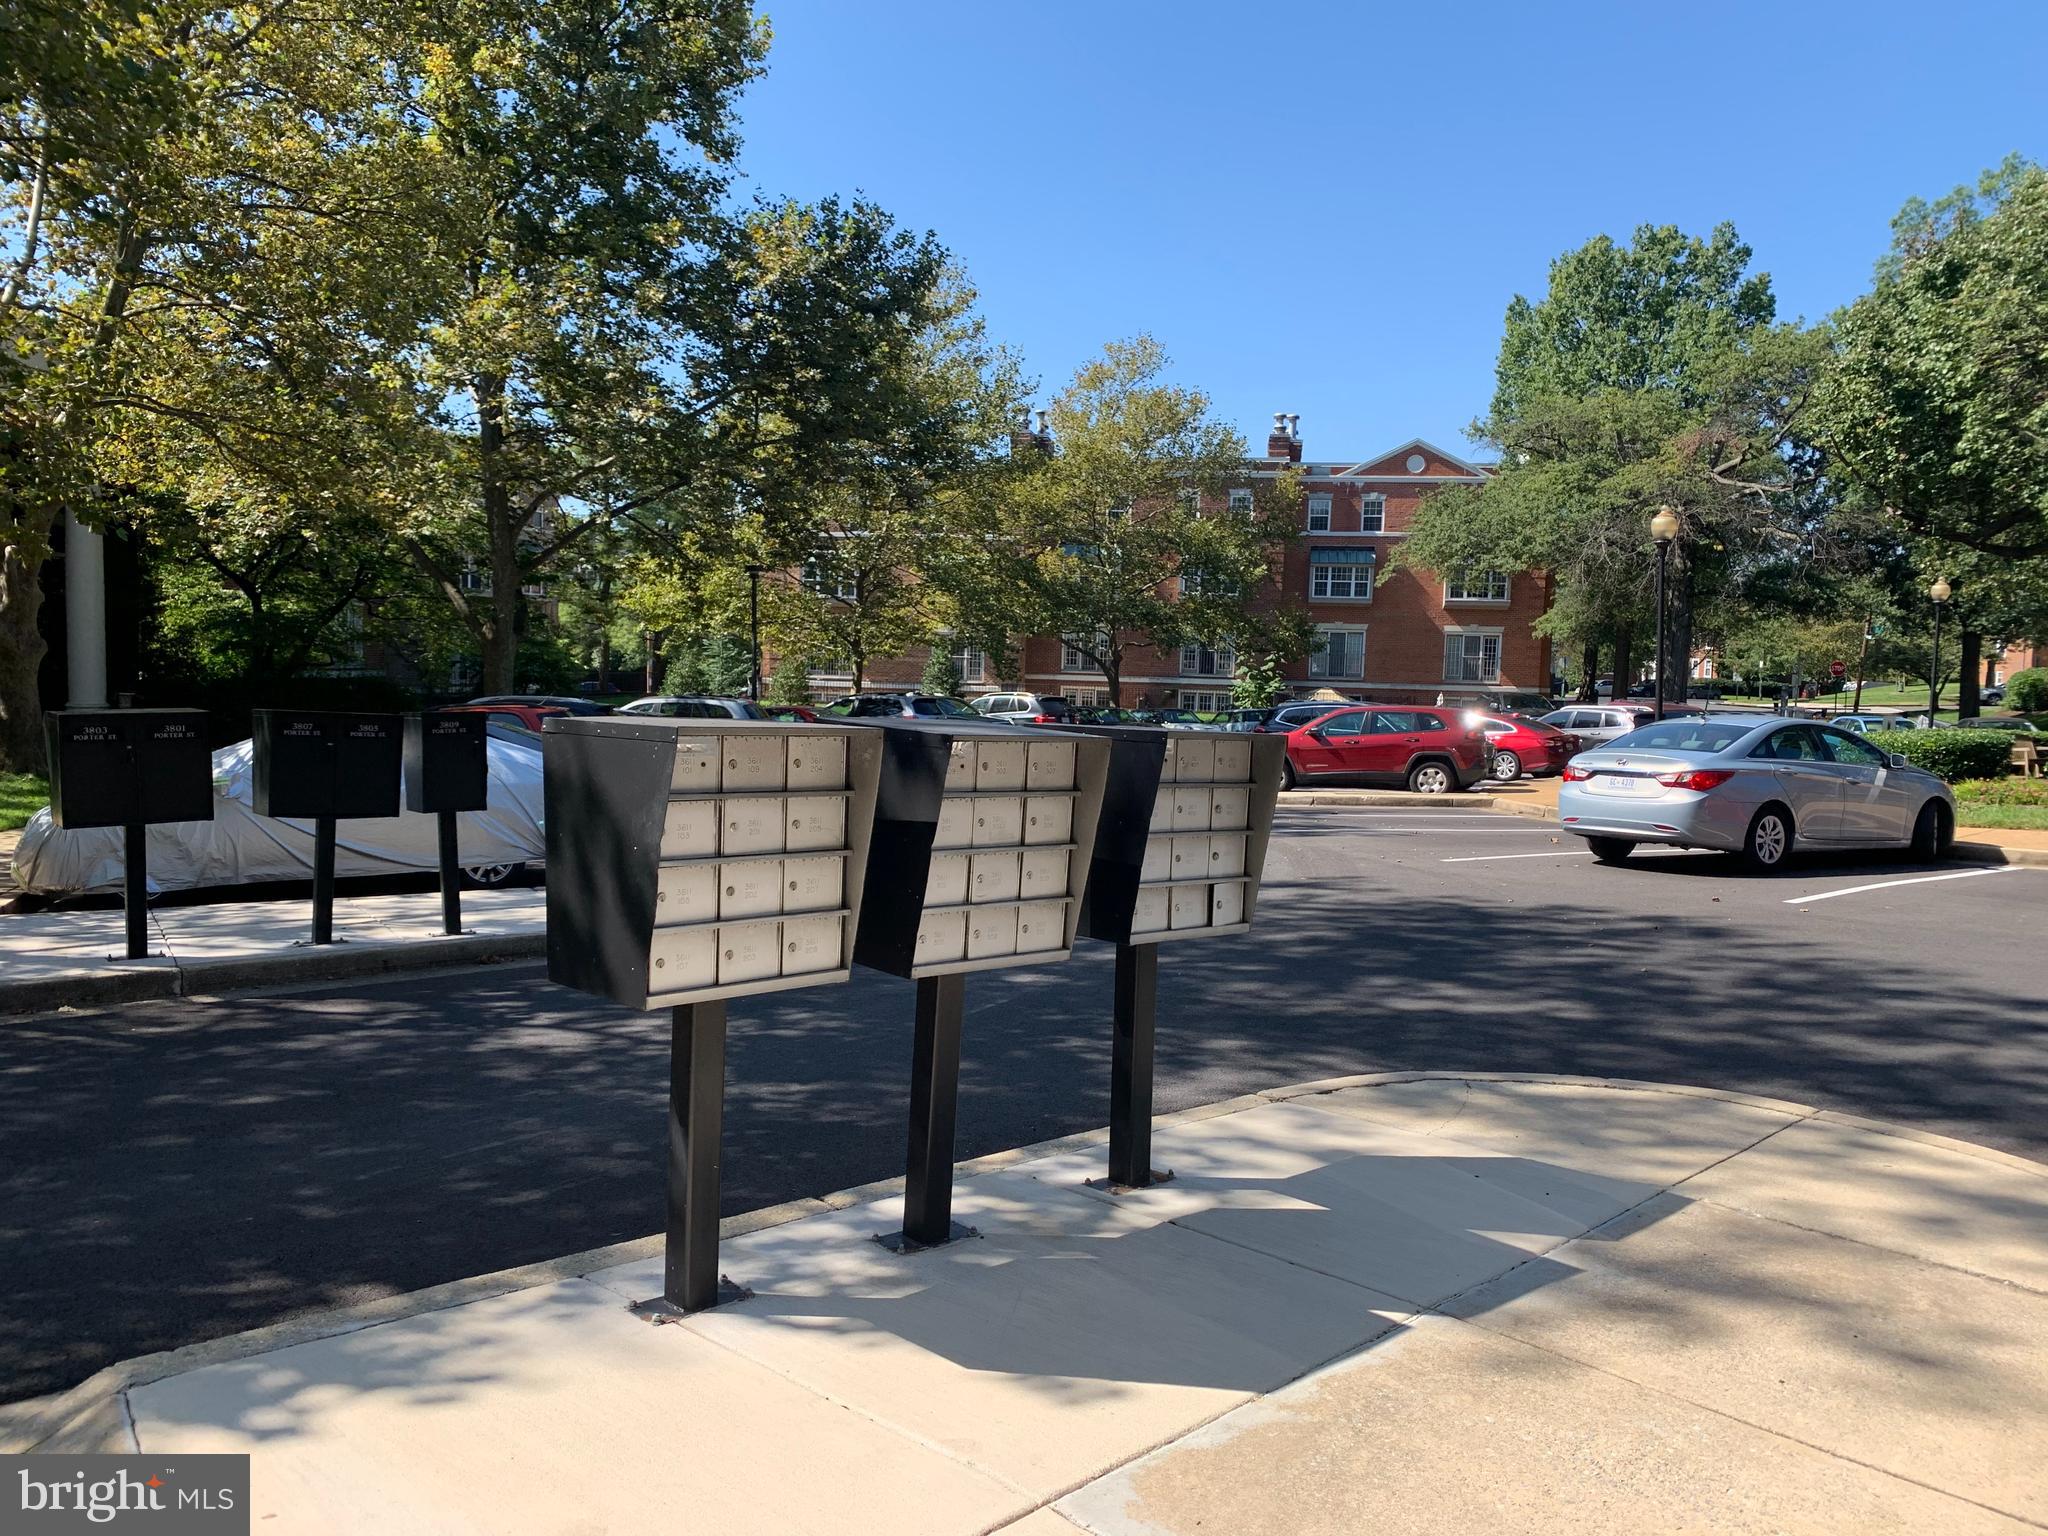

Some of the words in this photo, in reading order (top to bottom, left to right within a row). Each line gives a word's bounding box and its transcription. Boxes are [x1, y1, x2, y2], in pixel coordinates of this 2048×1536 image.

[163, 724, 185, 732] 3801
[292, 722, 313, 730] 3807
[82, 726, 108, 735] 3803
